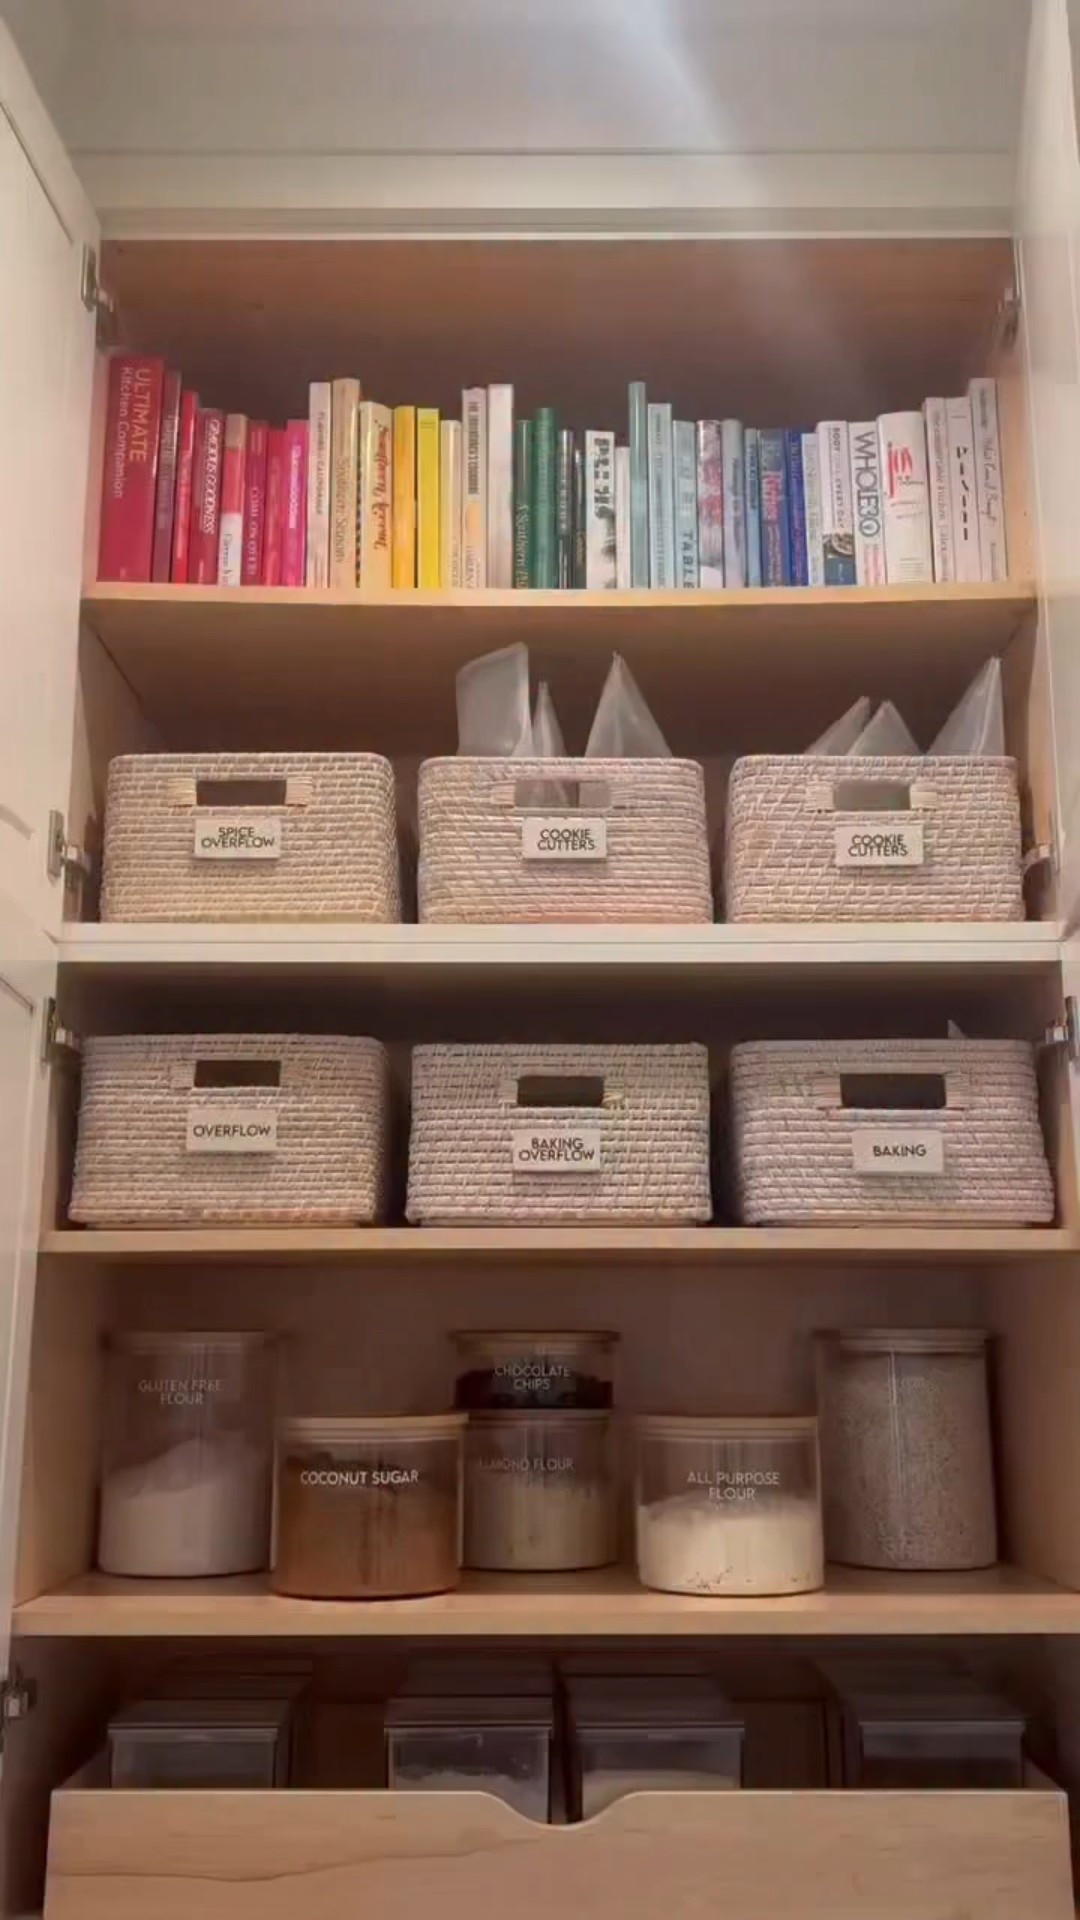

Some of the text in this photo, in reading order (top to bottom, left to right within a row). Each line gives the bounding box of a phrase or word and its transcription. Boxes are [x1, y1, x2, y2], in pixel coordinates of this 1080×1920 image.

[130, 368, 152, 463] ULTIMATE
[113, 366, 134, 499] Kitchen Companion
[832, 427, 843, 453] BODY
[202, 419, 221, 535] GRACIOUS GOODNESS
[854, 431, 881, 537] WHOLE30
[219, 826, 255, 838] SPICE
[540, 828, 591, 840] COOKIE
[201, 837, 275, 848] OVERFLOW
[537, 839, 596, 851] CUTTERS
[851, 834, 905, 846] COOKIE
[848, 845, 908, 857] CUTTERS
[193, 1124, 271, 1137] OVERFLOW
[531, 1137, 584, 1150] BAKING
[518, 1149, 595, 1161] OVERFLOW
[872, 1144, 927, 1157] BAKING
[494, 1365, 571, 1378] CHOCOLATE
[138, 1379, 222, 1392] GLUTEN FREE
[513, 1378, 551, 1390] CHIPS
[160, 1392, 204, 1405] FLOUR
[533, 1457, 574, 1471] FLOUR
[300, 1469, 419, 1485] COCONUT SUGAR
[686, 1471, 780, 1486] ALL PURPOSE
[709, 1487, 755, 1500] FLOUR
